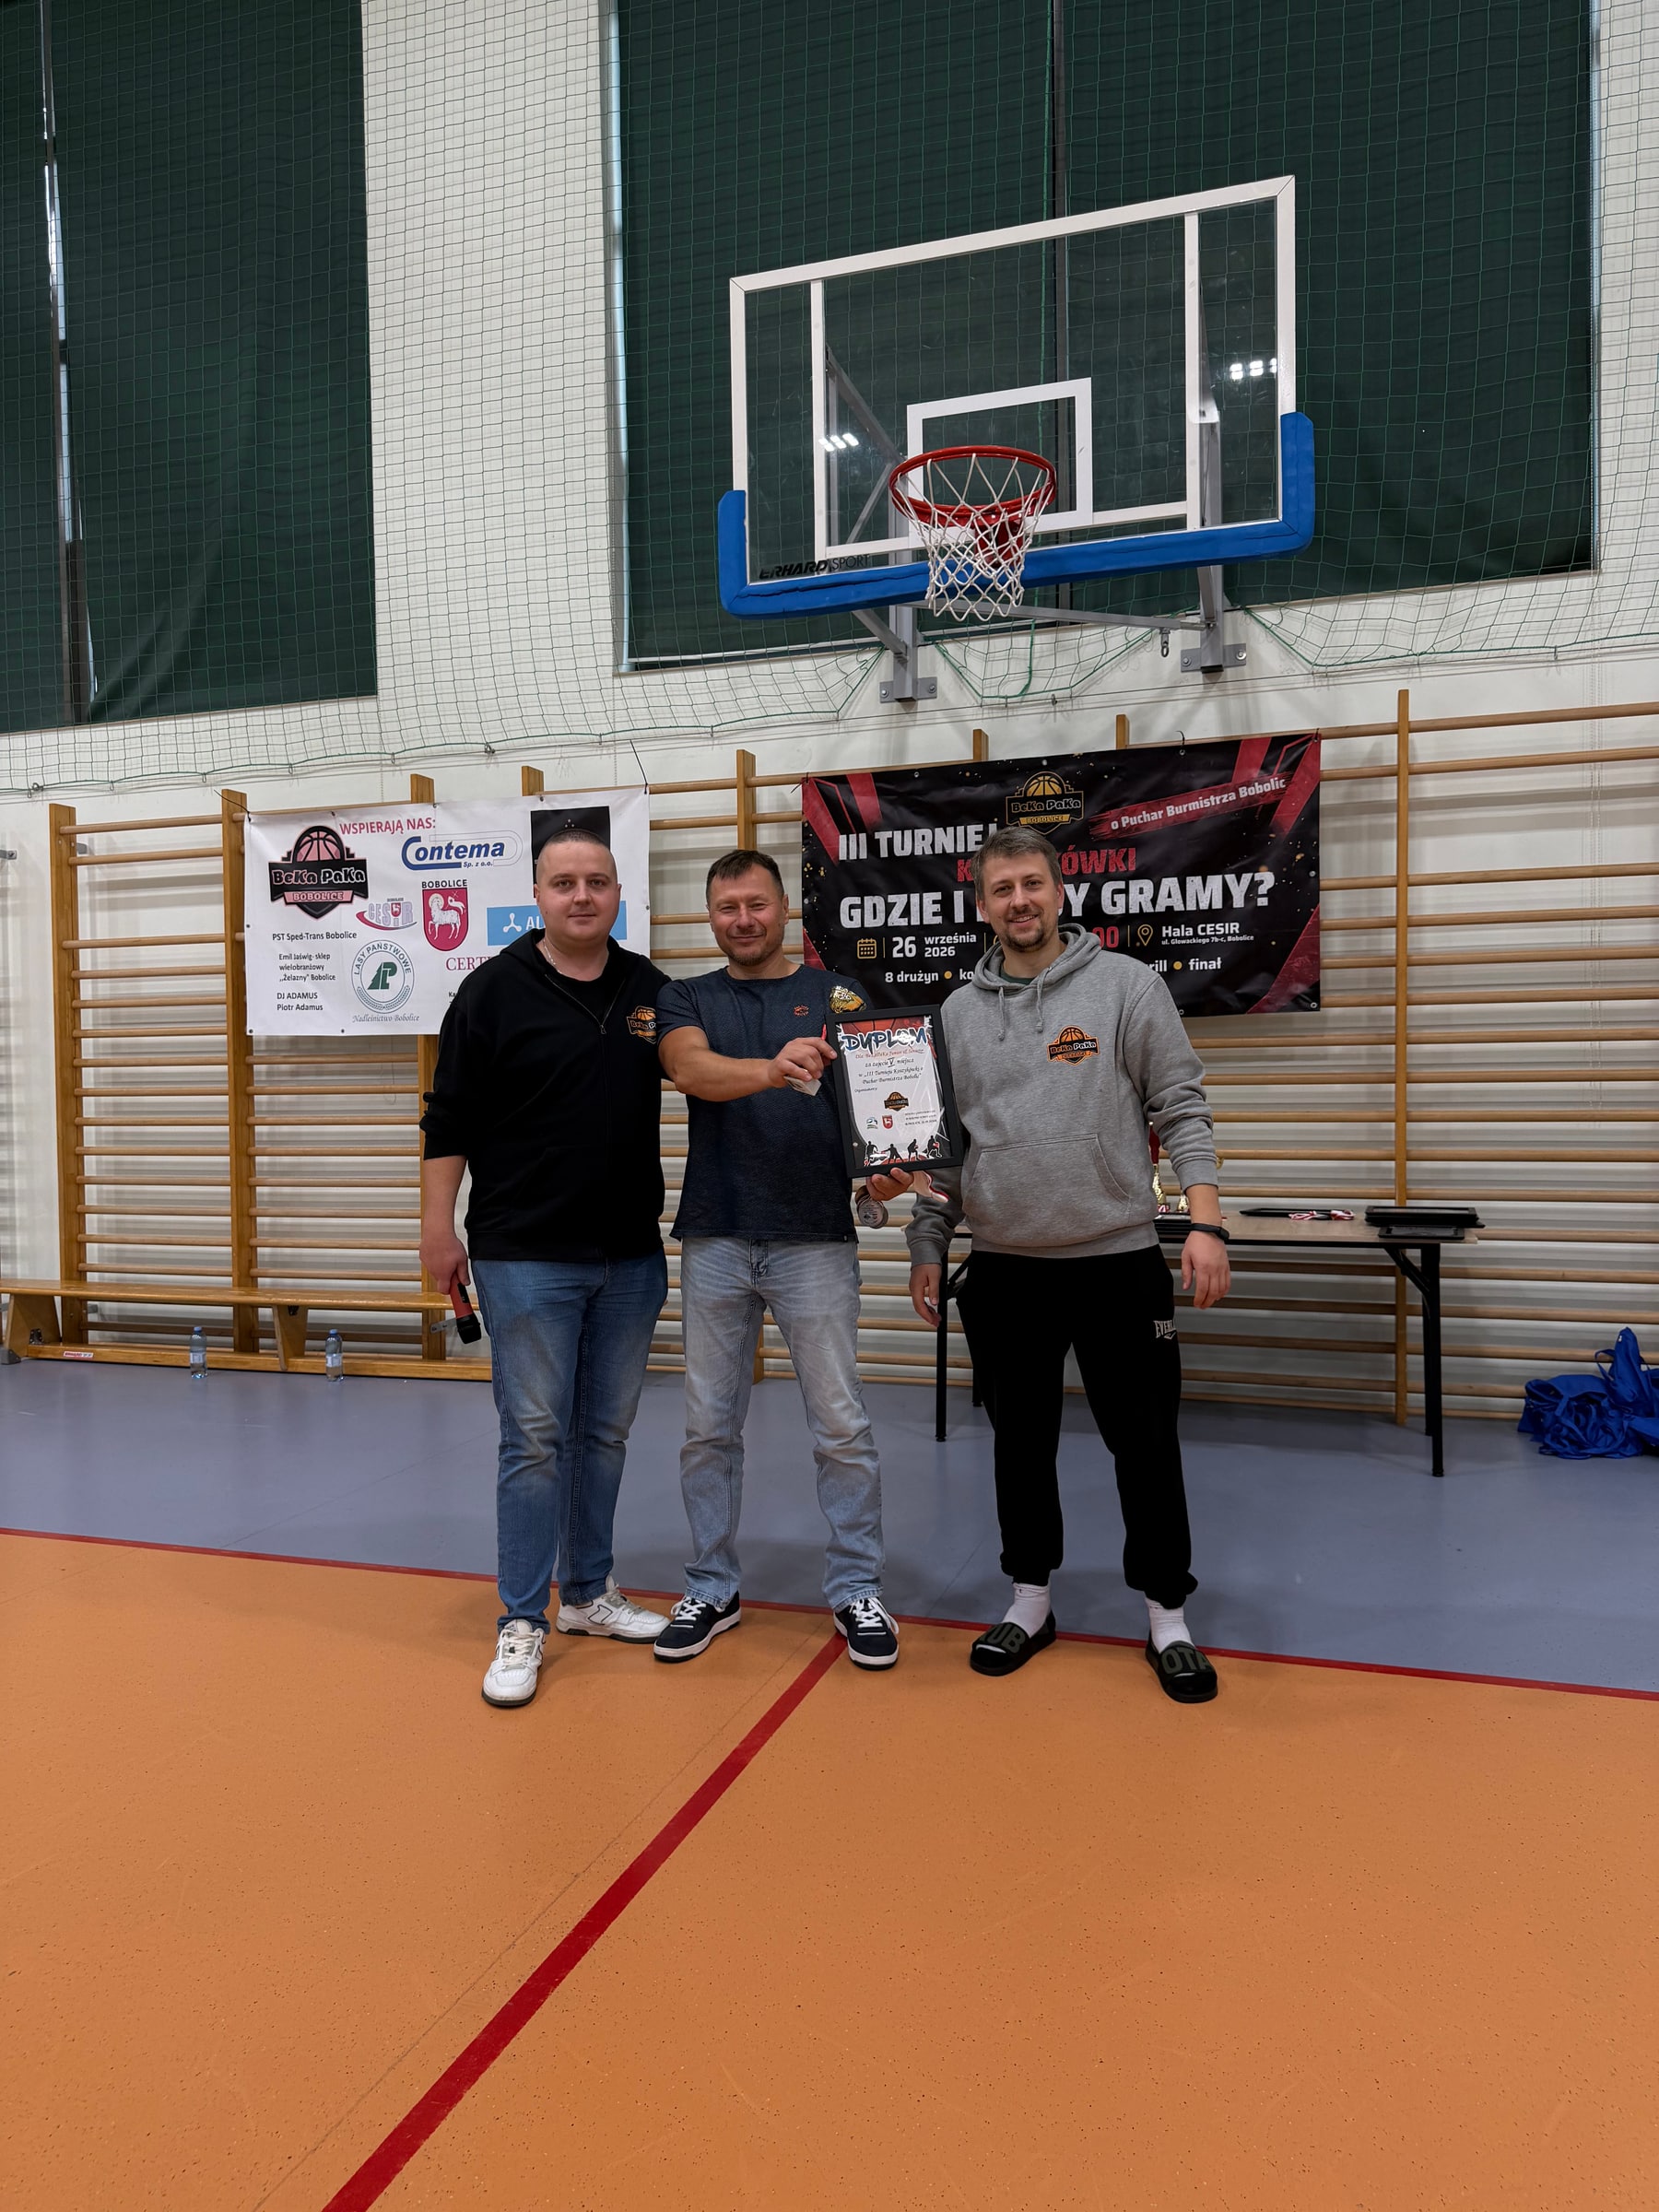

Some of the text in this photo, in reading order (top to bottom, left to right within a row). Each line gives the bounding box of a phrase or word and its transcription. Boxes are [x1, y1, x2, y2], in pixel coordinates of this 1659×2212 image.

[759, 554, 870, 579] ERHARD SPORT
[1111, 777, 1287, 830] o Puchar Burmistrza Bobolic
[339, 818, 437, 836] WSPIERAJĄ NAS:
[402, 836, 506, 870] Contema
[838, 832, 868, 861] III
[463, 861, 474, 869] Sp.
[272, 866, 367, 885] BeKa PaKa
[421, 878, 468, 889] BOBOLICE
[291, 890, 345, 902] BOBOLICE
[839, 891, 943, 929] GDZIE
[953, 890, 965, 923] I
[1100, 871, 1276, 915] GRAMY?
[286, 933, 324, 942] Sped-Trans
[325, 931, 358, 939] Bobolice
[1161, 923, 1241, 937] Hala CESIR
[1227, 934, 1254, 942] Bobolice
[891, 932, 977, 959] 26 września
[924, 947, 956, 958] 2026
[315, 953, 331, 961] sklep
[354, 941, 412, 975] LASY PAŃSTWOWE
[445, 956, 492, 971] CERT
[1188, 957, 1222, 971] finał
[885, 971, 894, 982] 8
[896, 969, 939, 983] drużyn
[276, 992, 318, 1001] DJ ADAMUS
[276, 1002, 324, 1012] Piotr Adamus
